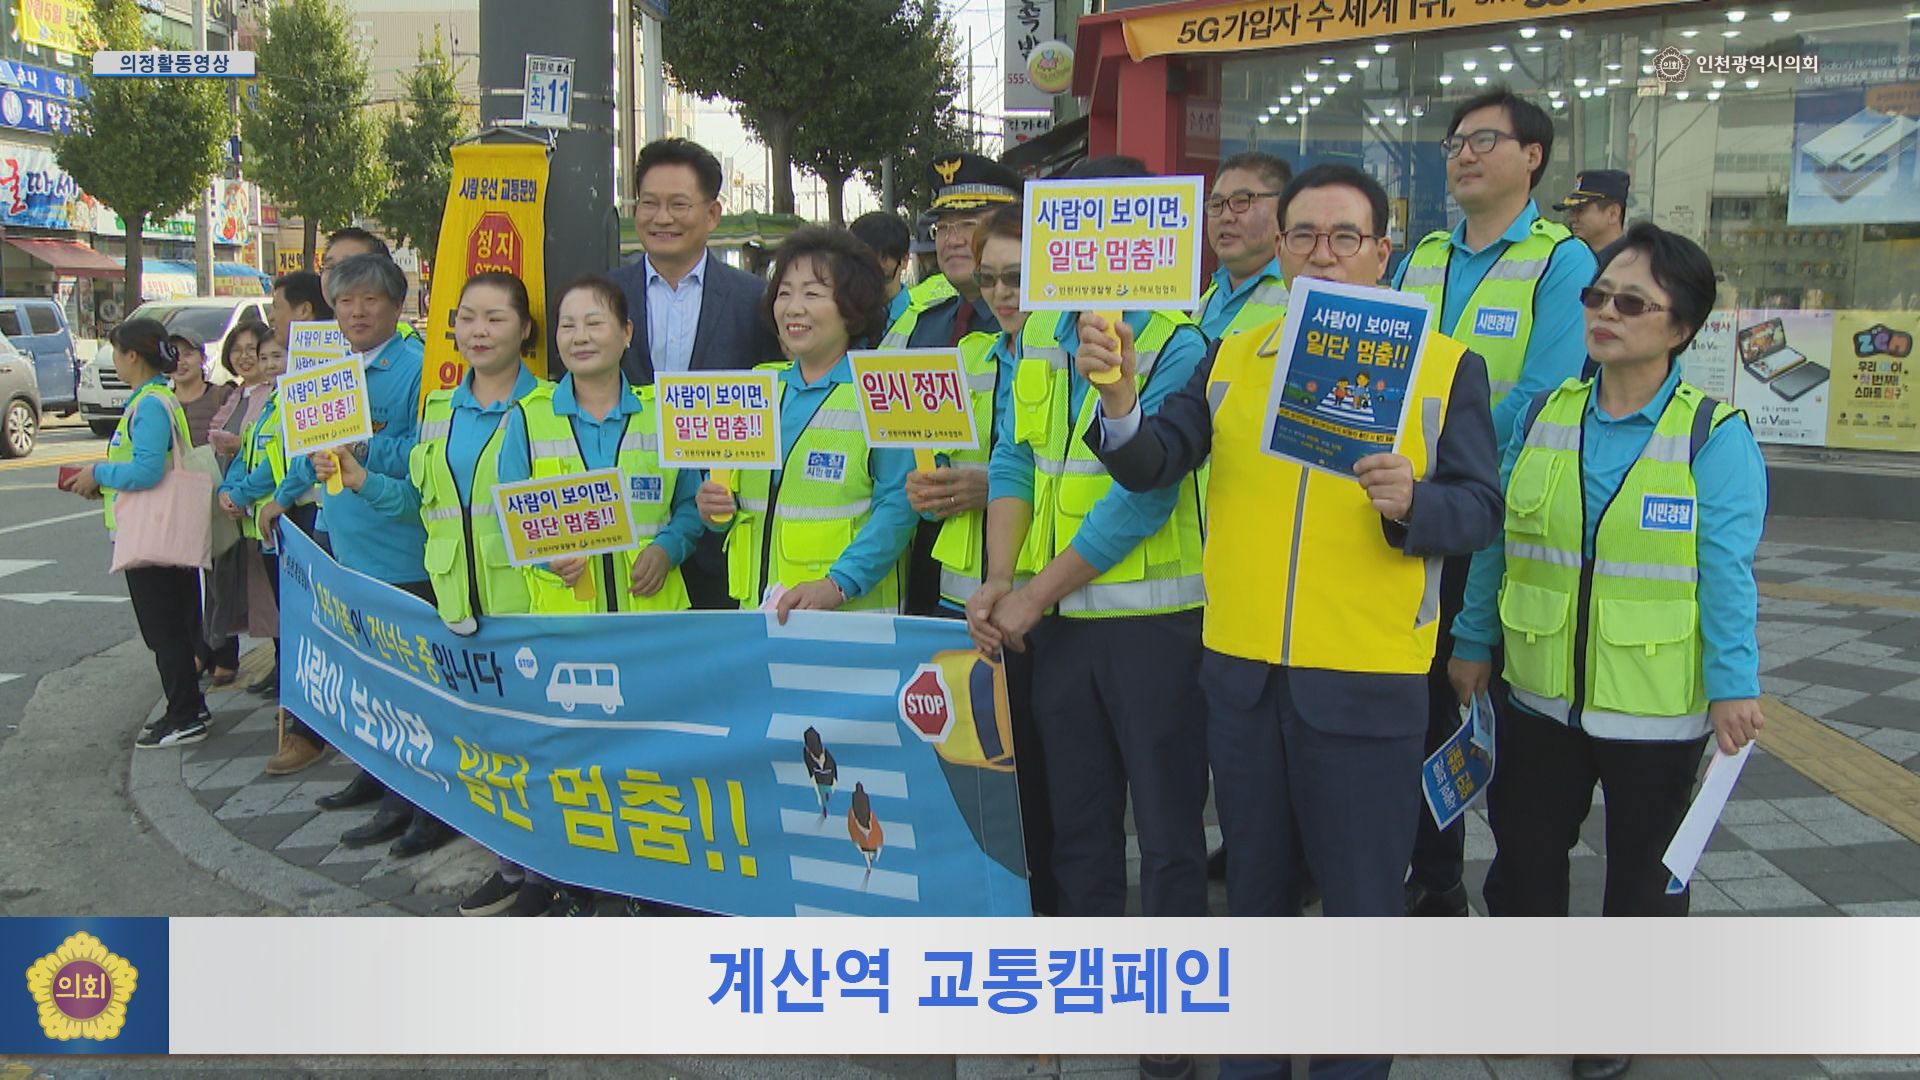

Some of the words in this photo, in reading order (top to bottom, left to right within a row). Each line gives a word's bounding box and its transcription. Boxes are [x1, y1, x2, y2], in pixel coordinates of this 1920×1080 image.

[459, 177, 479, 200] 사람
[480, 177, 498, 200] 우선
[500, 178, 537, 203] 교통문화
[1037, 197, 1102, 230] 사람이
[1110, 196, 1188, 229] 보이면,
[477, 229, 514, 261] 정지
[1049, 239, 1098, 272] 일단
[1105, 237, 1175, 272] 멈춤!!
[295, 331, 321, 347] 사람이
[1311, 306, 1362, 333] 사람이
[1364, 315, 1413, 341] 보이면,
[1477, 315, 1515, 333] 시민경찰
[1306, 330, 1350, 361] 일단
[1356, 339, 1410, 370] 멈춤!!
[286, 378, 319, 405] 사람이
[321, 368, 359, 393] 보이면,
[665, 384, 711, 408] 사람이
[715, 384, 769, 408] 보이면,
[862, 372, 911, 411] 일시
[912, 371, 964, 411] 정지
[295, 407, 319, 431] 일단
[322, 394, 356, 423] 멈춤!!
[675, 416, 709, 440] 일단
[713, 415, 762, 440] 멈춤!!
[508, 488, 558, 515] 사람이
[561, 480, 620, 505] 보이면,
[1645, 503, 1690, 524] 시민경찰
[522, 516, 559, 541] 일단
[563, 506, 616, 534] 멈춤!!
[517, 657, 535, 669] STOP
[295, 634, 348, 733] 사람이
[350, 677, 450, 793] 보이면,
[907, 693, 944, 715] STOP
[453, 735, 534, 832] 일단
[548, 764, 758, 877] 멈춤!!
